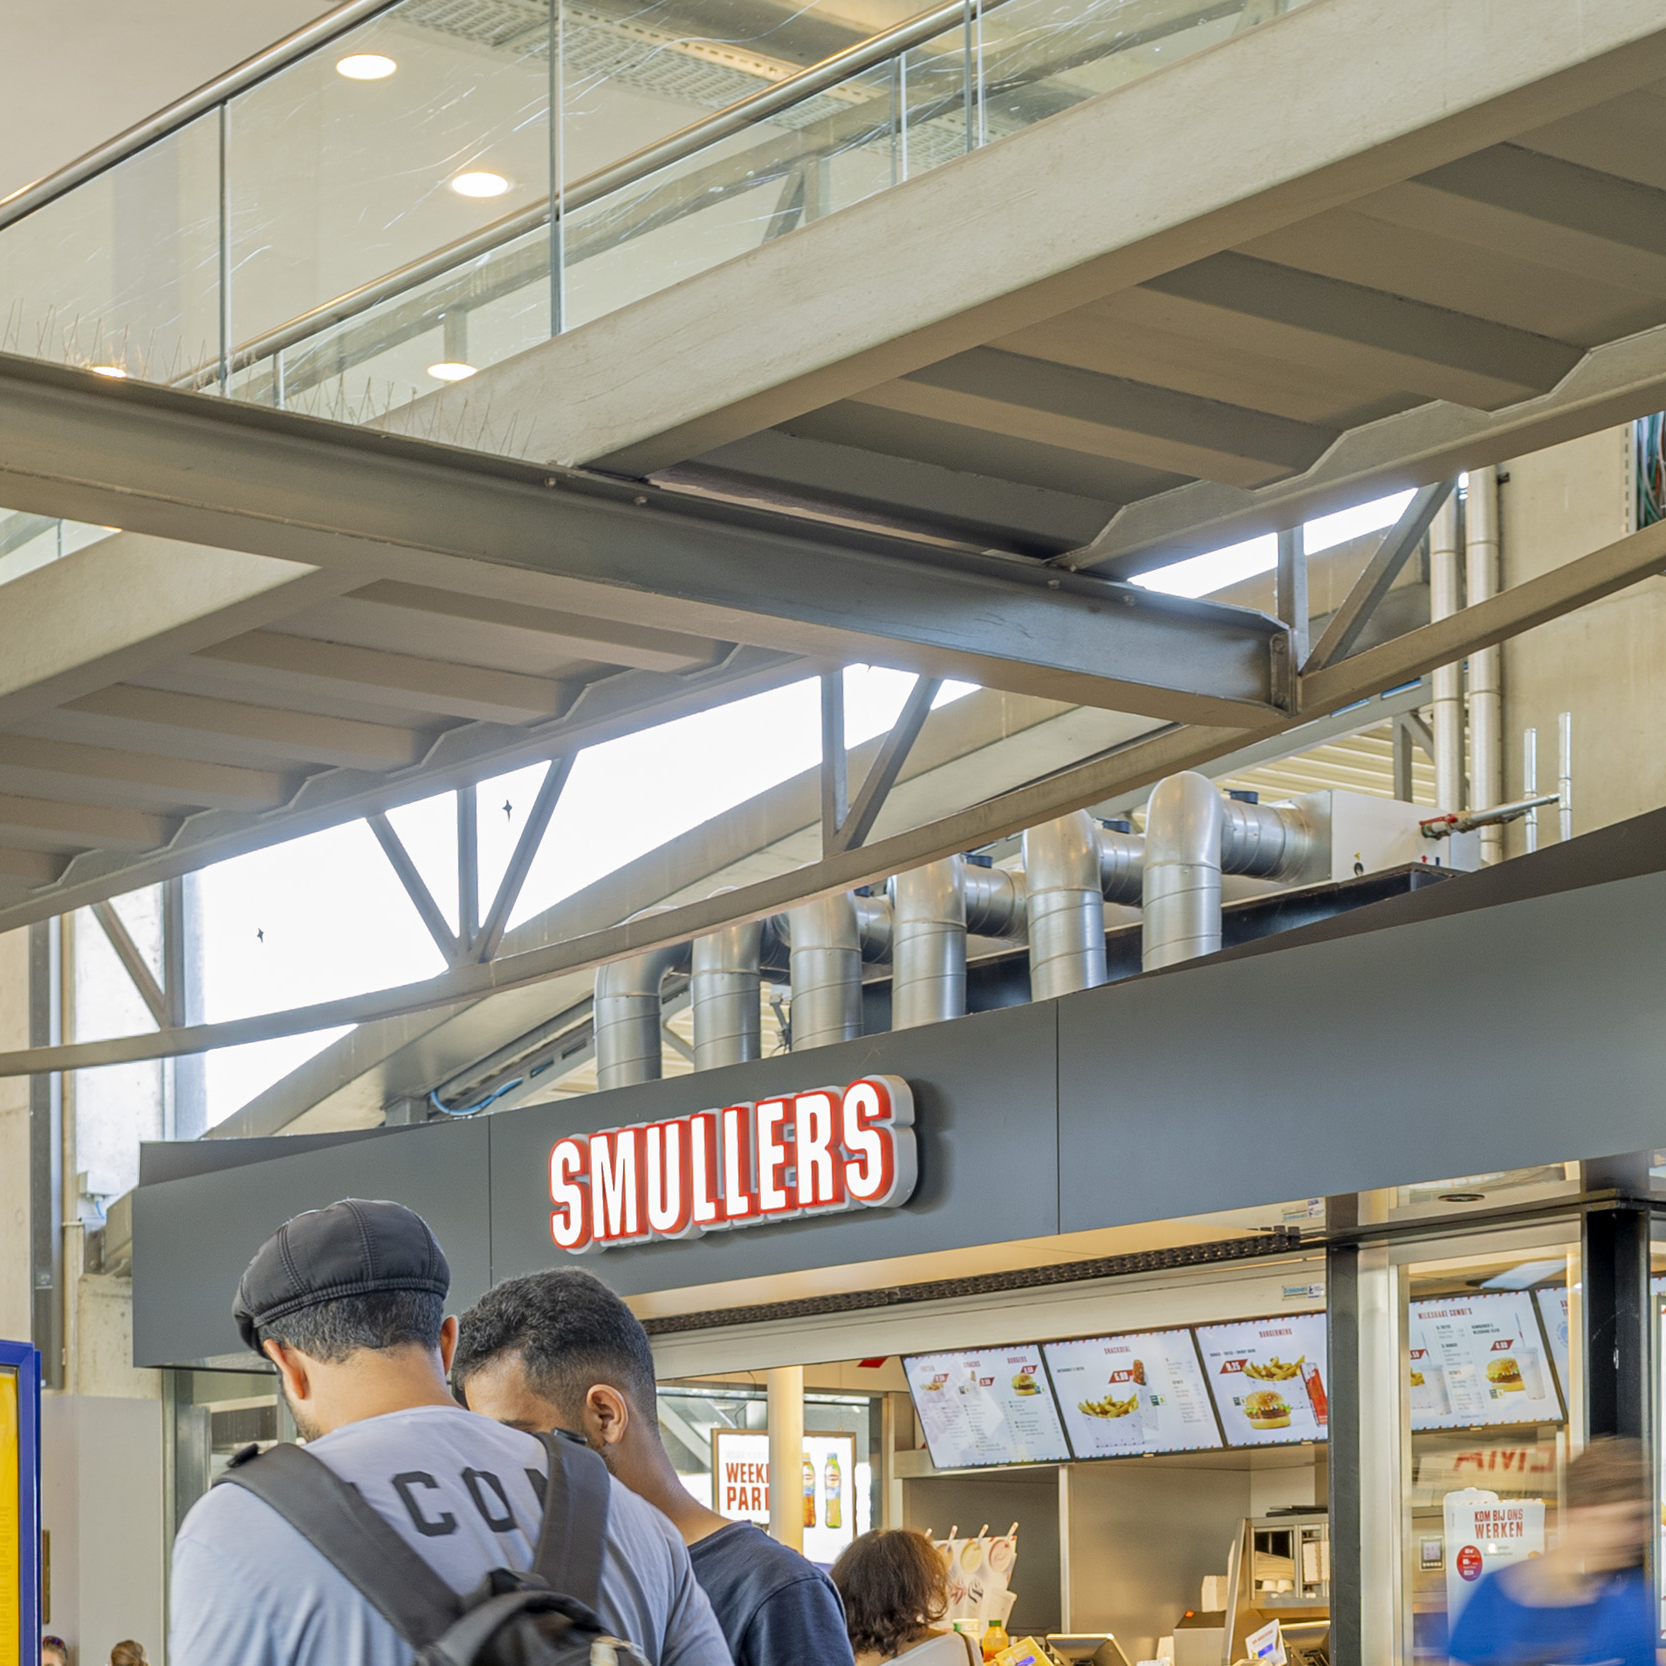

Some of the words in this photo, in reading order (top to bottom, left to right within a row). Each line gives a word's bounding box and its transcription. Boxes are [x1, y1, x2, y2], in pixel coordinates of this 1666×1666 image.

[549, 1078, 895, 1251] SMULLERS
[726, 1463, 770, 1484] WEEK
[727, 1486, 770, 1511] PAR
[1474, 1511, 1491, 1522] KOM
[1493, 1510, 1505, 1521] BIJ
[1507, 1508, 1523, 1520] ONS
[1475, 1521, 1523, 1539] WERKEN
